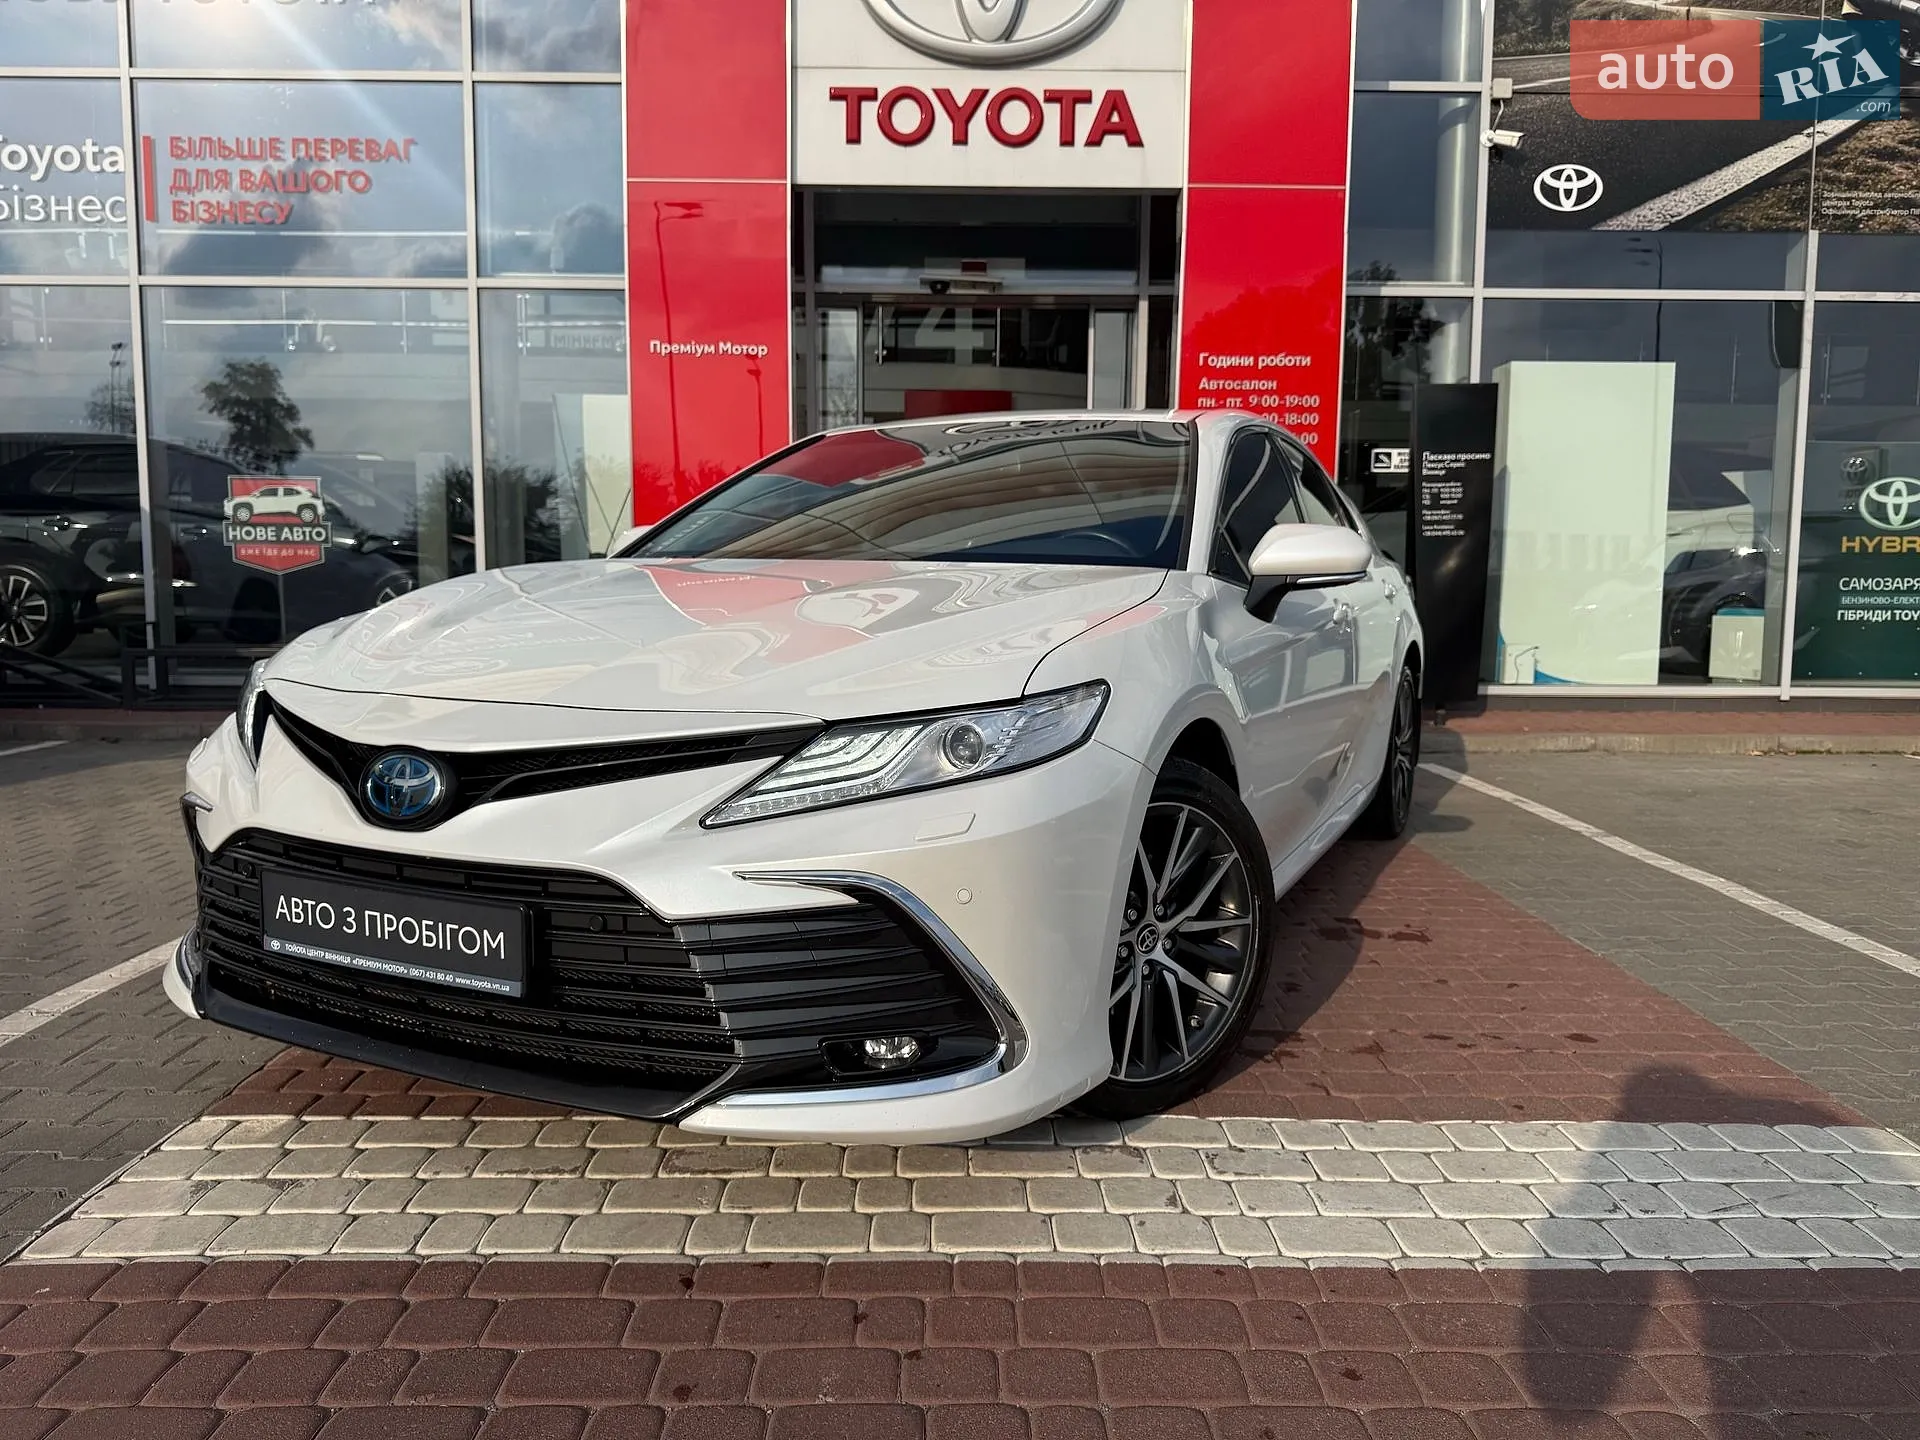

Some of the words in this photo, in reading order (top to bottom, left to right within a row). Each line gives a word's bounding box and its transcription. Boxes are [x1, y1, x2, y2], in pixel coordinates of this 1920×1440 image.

[828, 85, 1145, 148] TOYOTA
[0, 133, 126, 181] oyota
[168, 136, 283, 161] БІЛЬШЕ
[291, 137, 416, 162] ПЕРЕВАГ
[169, 168, 230, 195] ДЛЯ
[238, 168, 373, 194] ВАШОГО
[171, 200, 293, 224] БІЗНЕСУ
[649, 340, 716, 357] Преміум
[718, 340, 769, 358] Мотор
[1198, 352, 1254, 368] Години
[1257, 352, 1312, 370] роботи
[1198, 376, 1277, 391] Автосалон
[1248, 394, 1321, 408] 9:00-19:00
[228, 525, 277, 541] НОВЕ
[280, 526, 327, 542] АВТО
[1837, 609, 1892, 622] ГІБРИДИ
[275, 894, 336, 930] АВТО
[342, 906, 357, 934] З
[364, 909, 505, 960] ПРОБІГОМ
[285, 943, 307, 955] ТОЙОТА
[306, 948, 325, 959] ЦЕНТР
[325, 951, 351, 964] ВІННИЦЯ
[409, 967, 426, 978] (067)
[426, 971, 437, 980] 431
[437, 973, 445, 981] 80
[445, 974, 454, 983] 40
[455, 976, 510, 993] www.toyota.vn.ua
